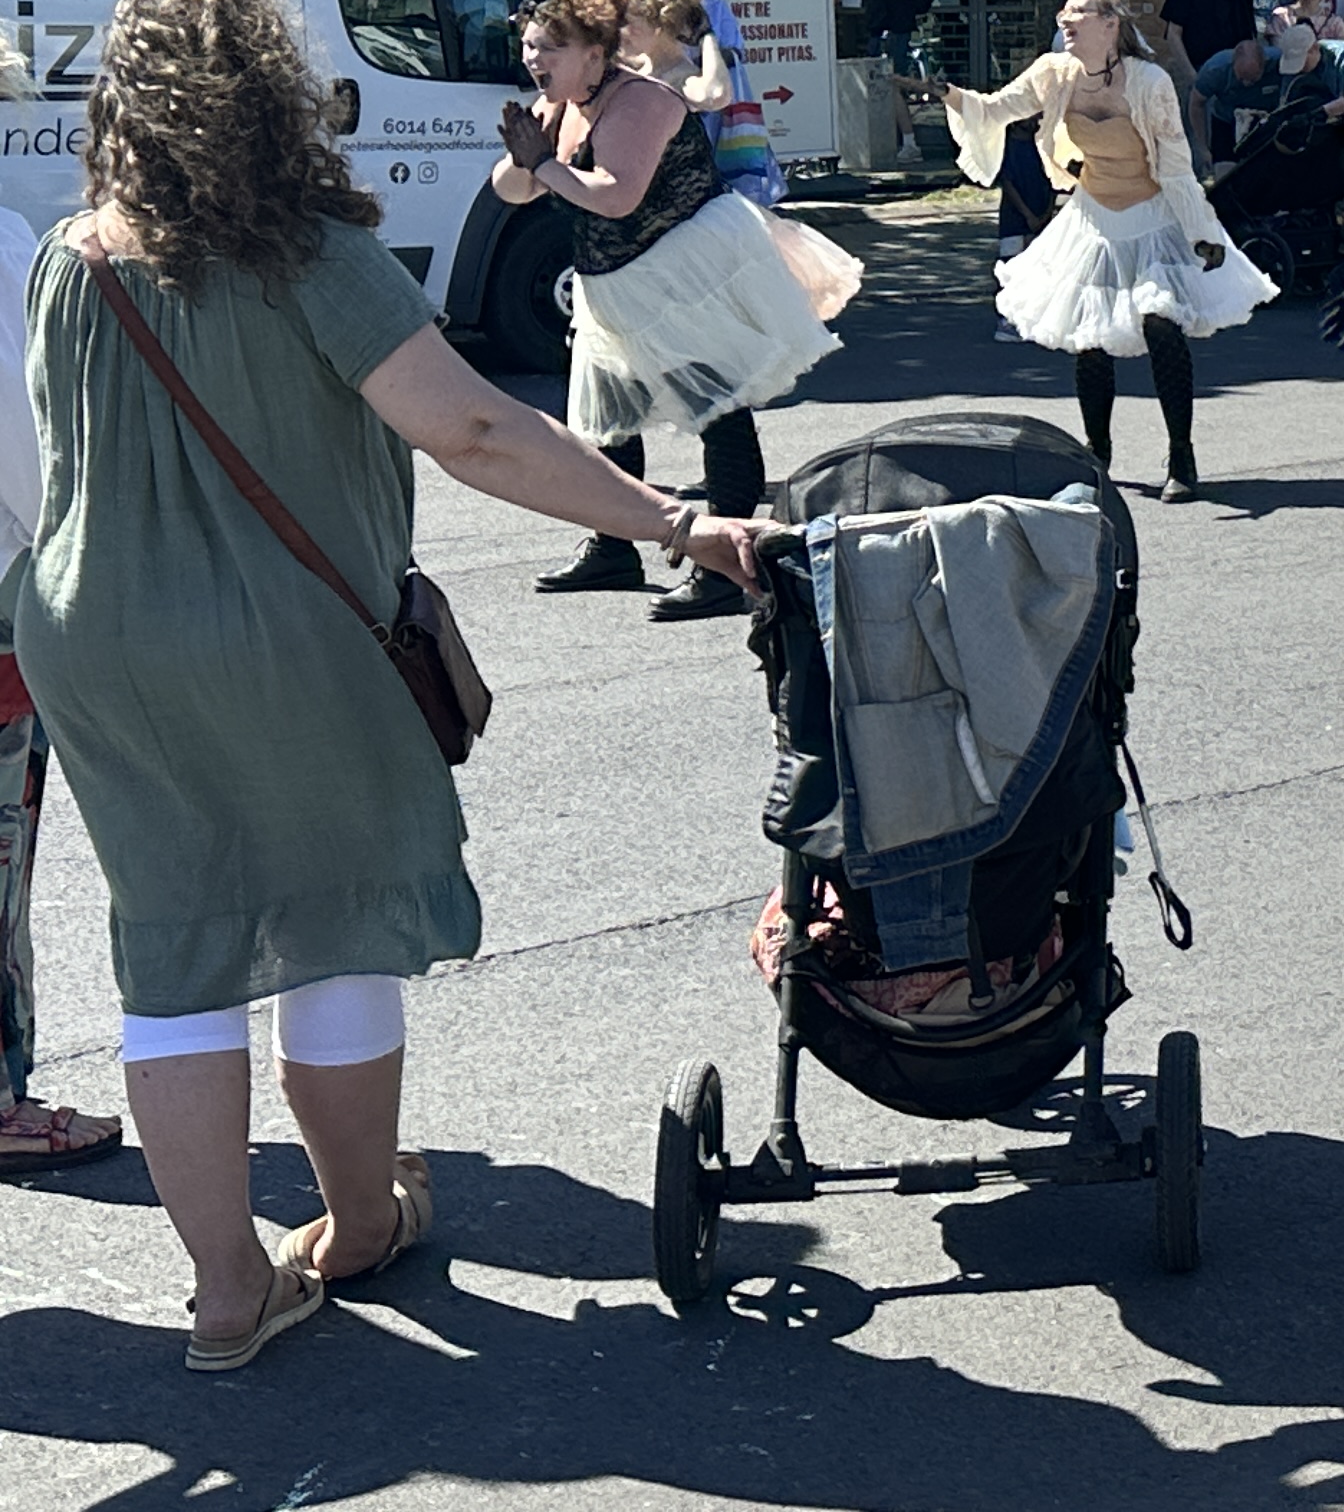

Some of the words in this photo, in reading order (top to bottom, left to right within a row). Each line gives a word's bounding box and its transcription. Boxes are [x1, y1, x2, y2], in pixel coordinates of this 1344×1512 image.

[739, 22, 809, 41] ASSIONATE
[742, 46, 774, 64] BOUT
[777, 44, 818, 62] PITAS.
[383, 117, 426, 136] 6014
[432, 117, 476, 137] 6475
